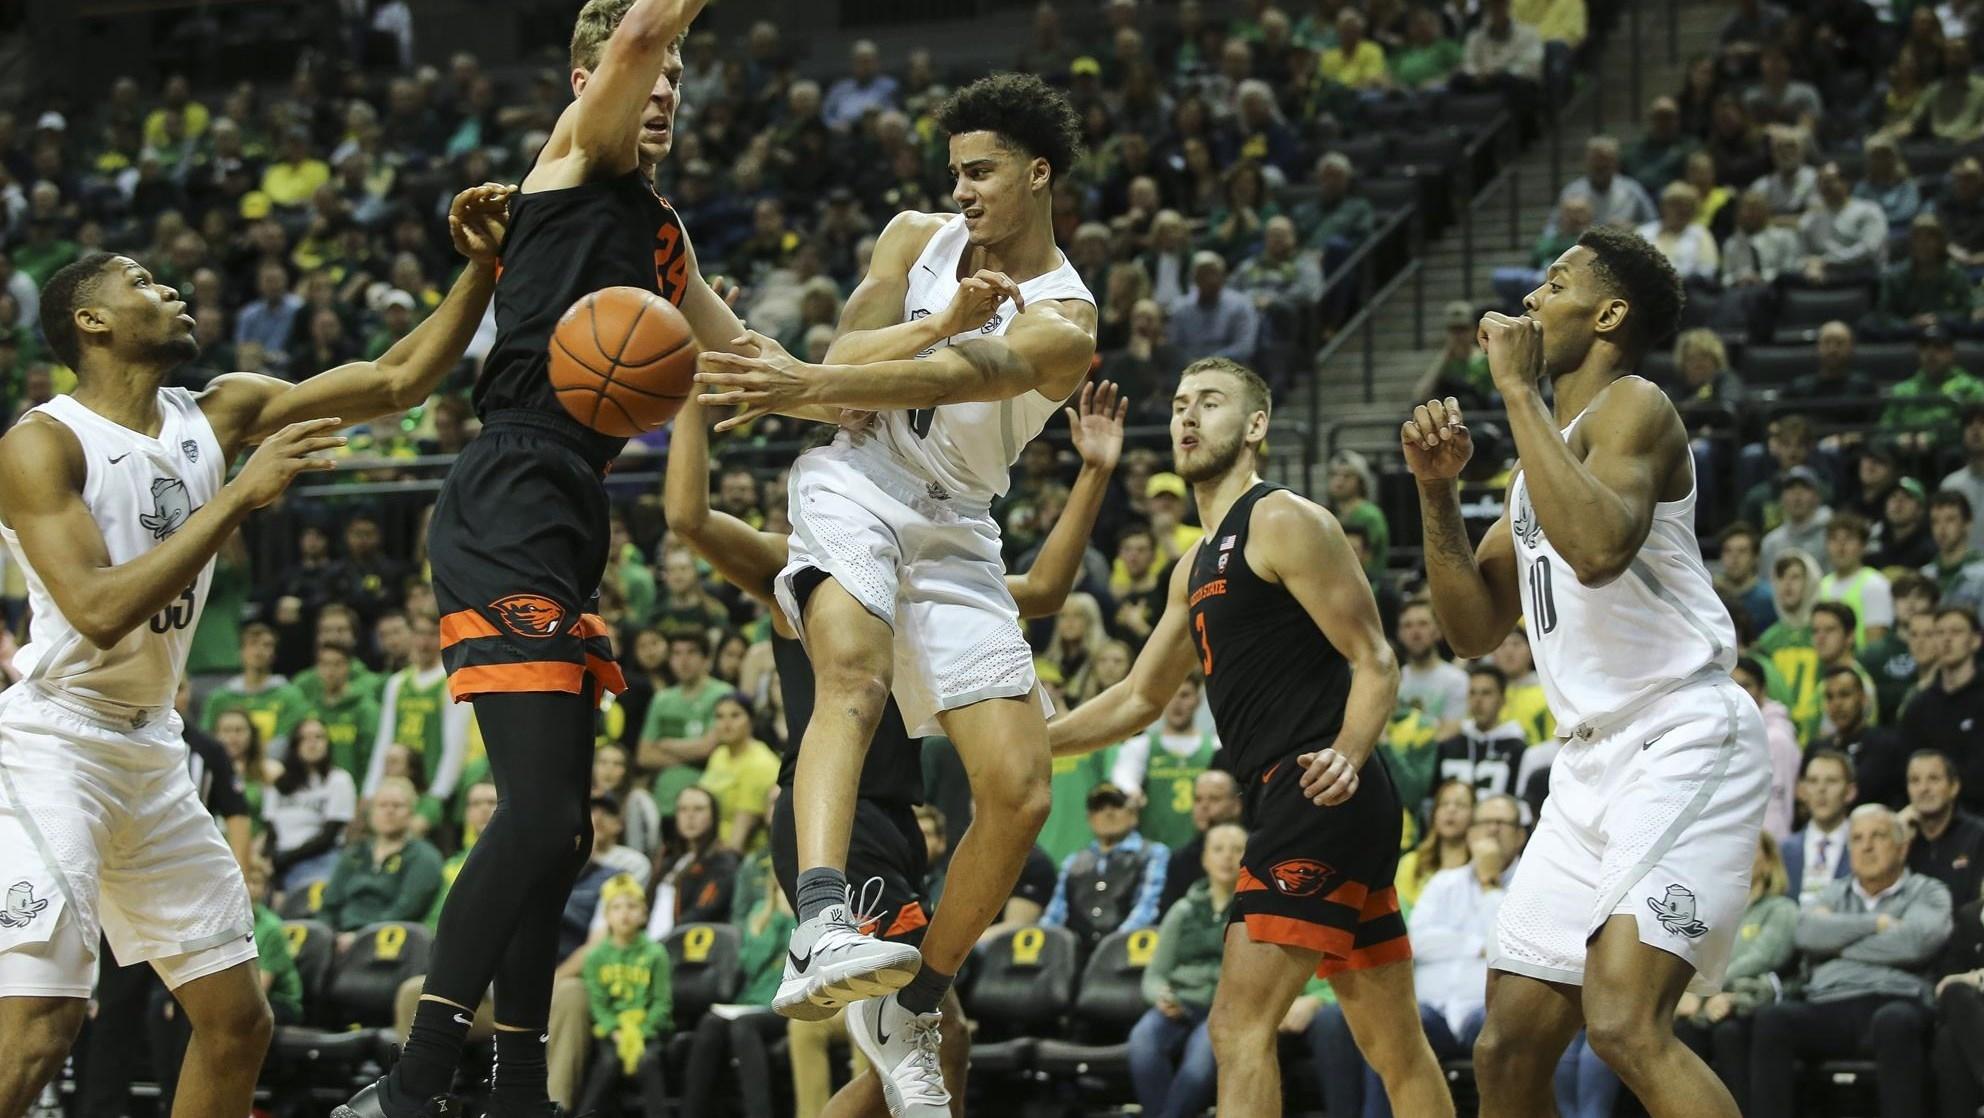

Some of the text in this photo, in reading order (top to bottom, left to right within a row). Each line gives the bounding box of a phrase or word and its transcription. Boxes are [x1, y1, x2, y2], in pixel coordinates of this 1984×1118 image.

[654, 222, 689, 308] 24
[1529, 555, 1557, 641] 10
[1196, 612, 1213, 675] 3
